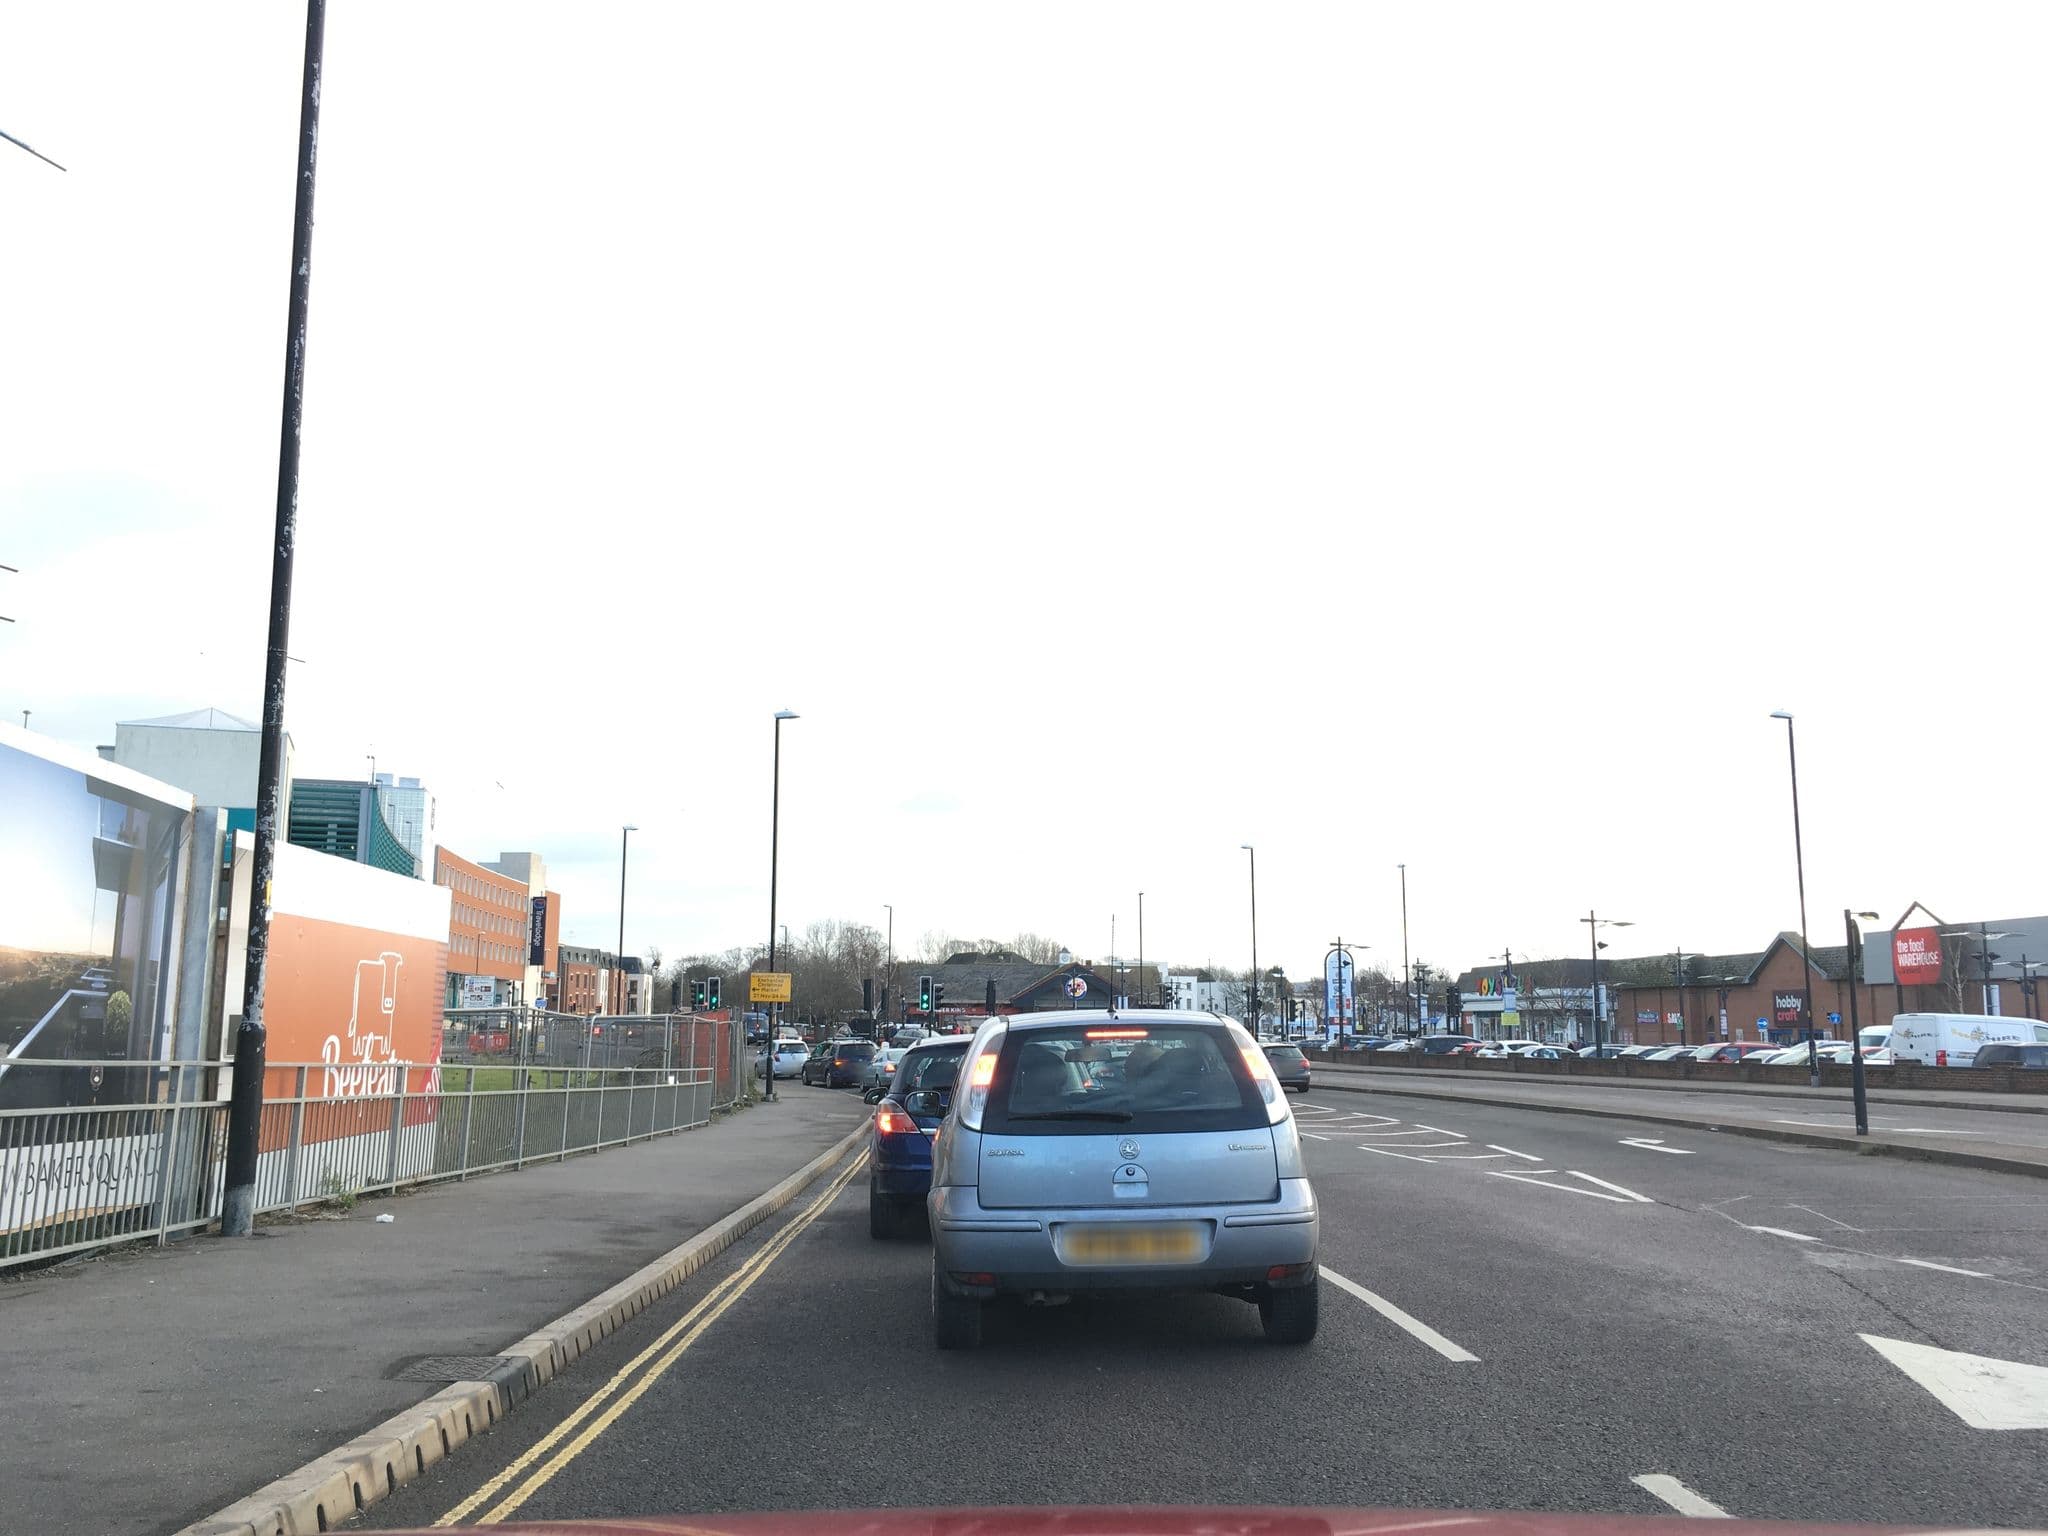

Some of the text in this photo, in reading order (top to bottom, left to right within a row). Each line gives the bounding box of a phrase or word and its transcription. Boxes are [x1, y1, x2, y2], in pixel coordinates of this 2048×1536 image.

[534, 908, 545, 947] Travelodge
[1896, 936, 1926, 954] the food
[1897, 951, 1940, 967] WAREHOUSE
[1476, 976, 1503, 997] TOYS
[1776, 995, 1802, 1012] hobby
[1777, 1008, 1798, 1021] craft
